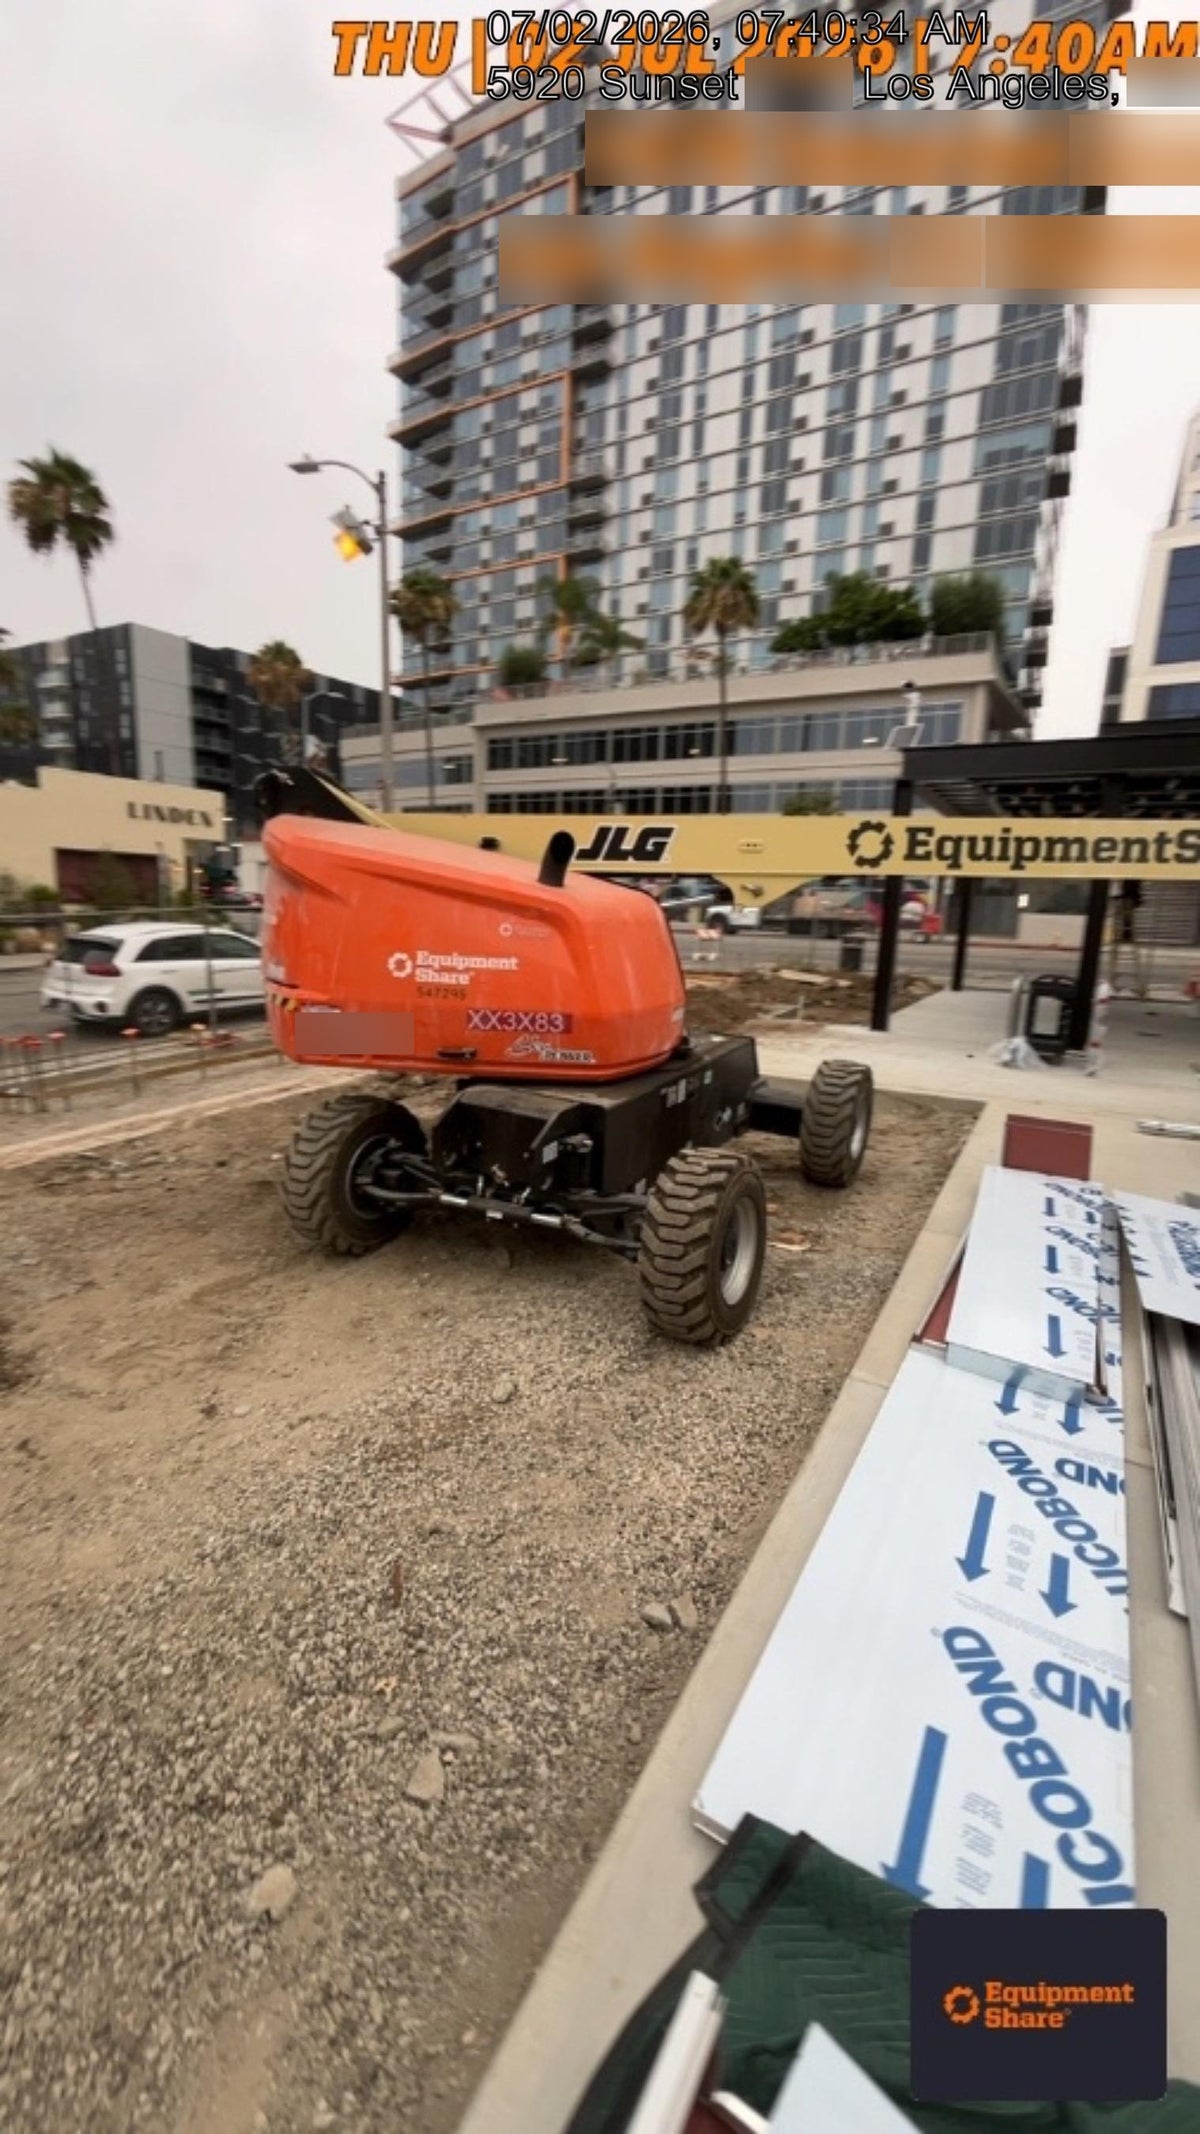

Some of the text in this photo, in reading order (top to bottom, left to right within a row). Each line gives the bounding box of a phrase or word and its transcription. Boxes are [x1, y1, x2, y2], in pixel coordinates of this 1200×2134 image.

[573, 826, 677, 862] JLG
[415, 950, 520, 971] Equipment
[415, 967, 471, 985] Share
[468, 1009, 565, 1033] XX3X83
